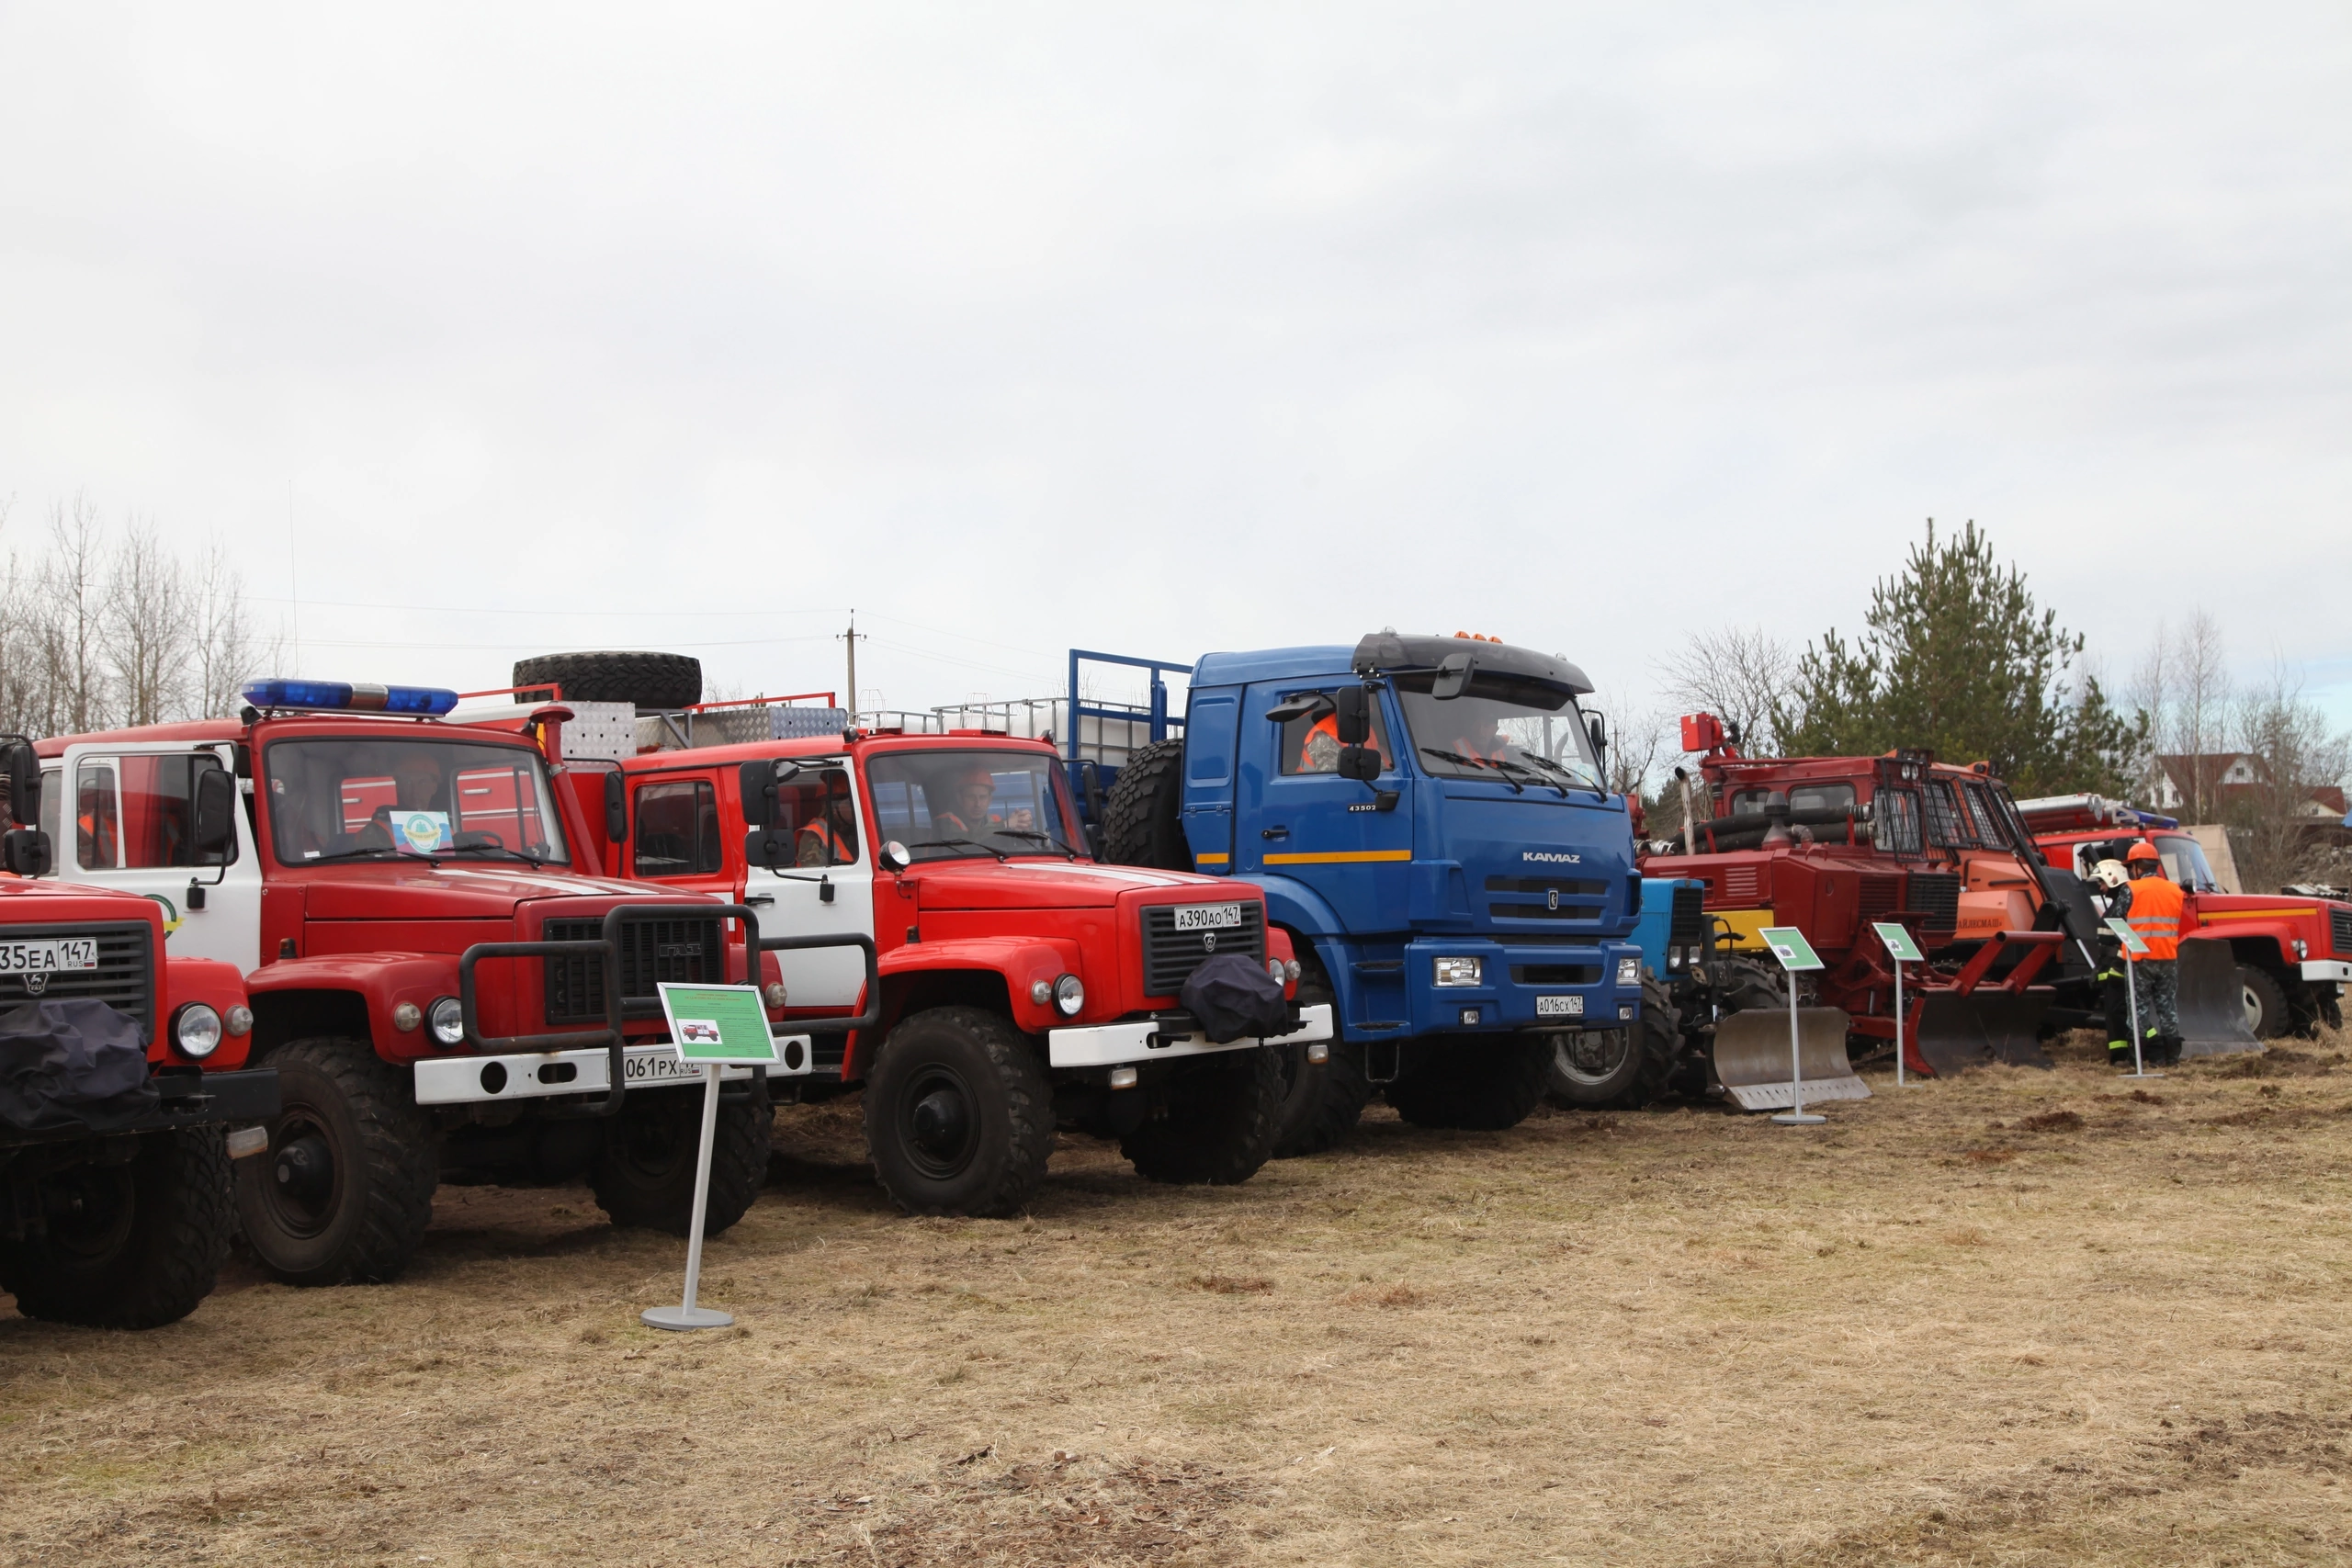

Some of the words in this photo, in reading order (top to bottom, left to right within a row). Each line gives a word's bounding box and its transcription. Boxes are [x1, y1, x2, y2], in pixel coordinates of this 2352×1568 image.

[1522, 852, 1580, 863] KAMAZ
[1180, 909, 1222, 928] А390АО
[1224, 907, 1238, 919] 147
[61, 942, 91, 960] 147
[659, 943, 702, 956] ГАЗ
[1540, 998, 1569, 1012] А016СХ
[1570, 998, 1581, 1009] 147
